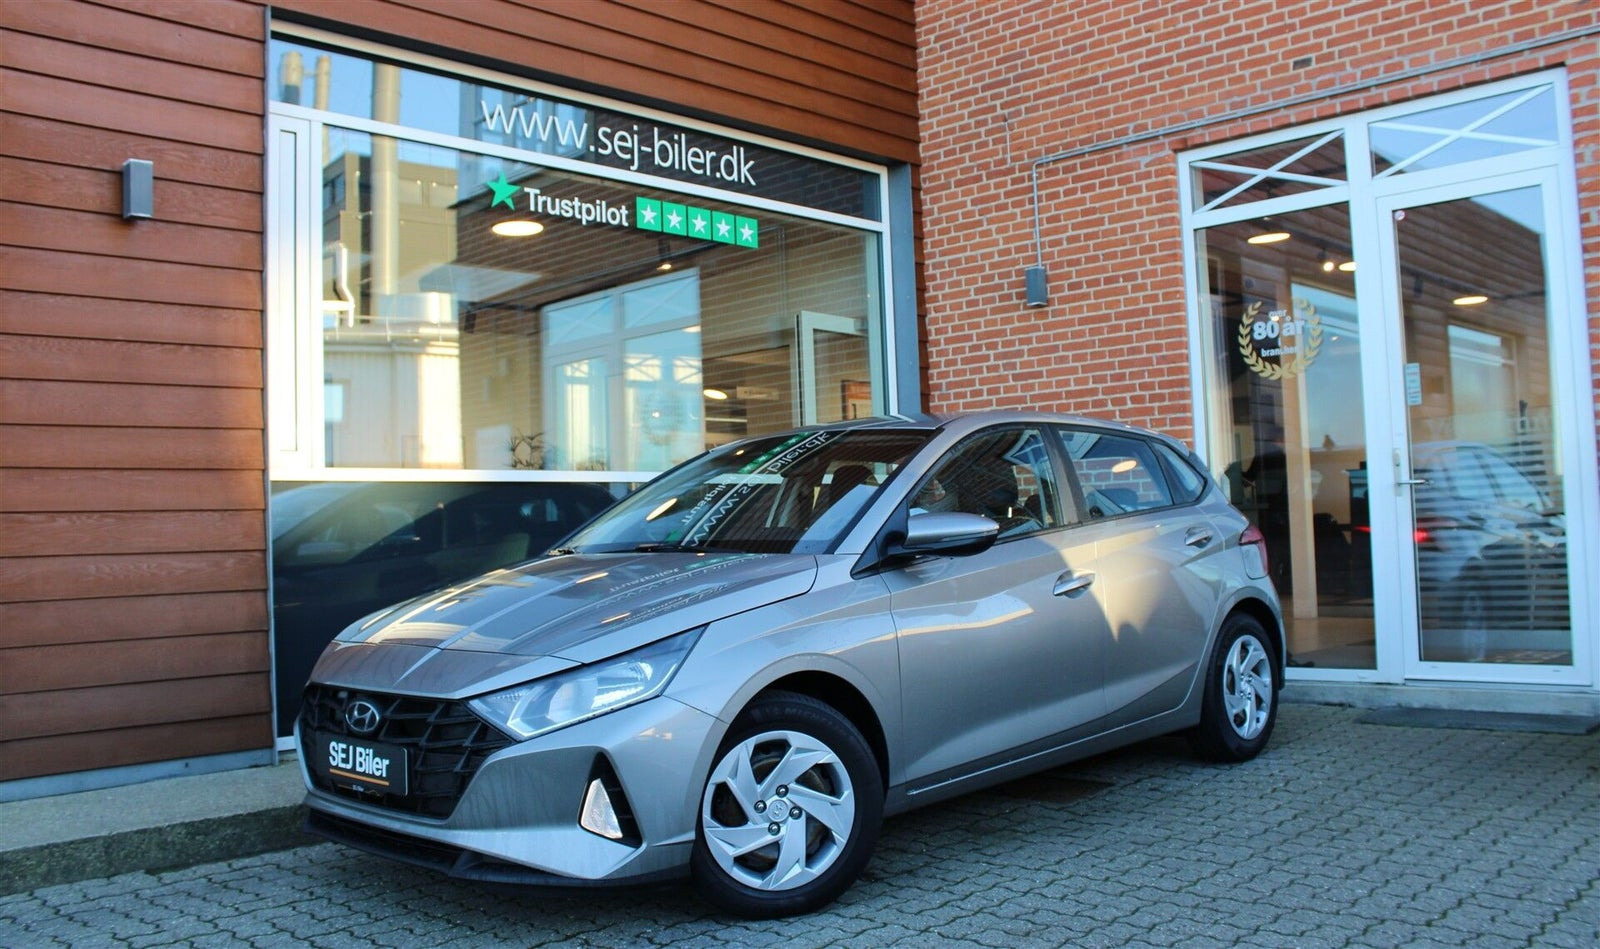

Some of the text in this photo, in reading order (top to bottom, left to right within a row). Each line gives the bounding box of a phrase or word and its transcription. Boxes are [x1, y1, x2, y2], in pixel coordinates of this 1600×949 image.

[481, 100, 757, 186] www.sej-biler.dk
[523, 186, 629, 226] Trustpilot
[1253, 315, 1305, 340] 80 år
[329, 741, 390, 777] SEJ Biler
